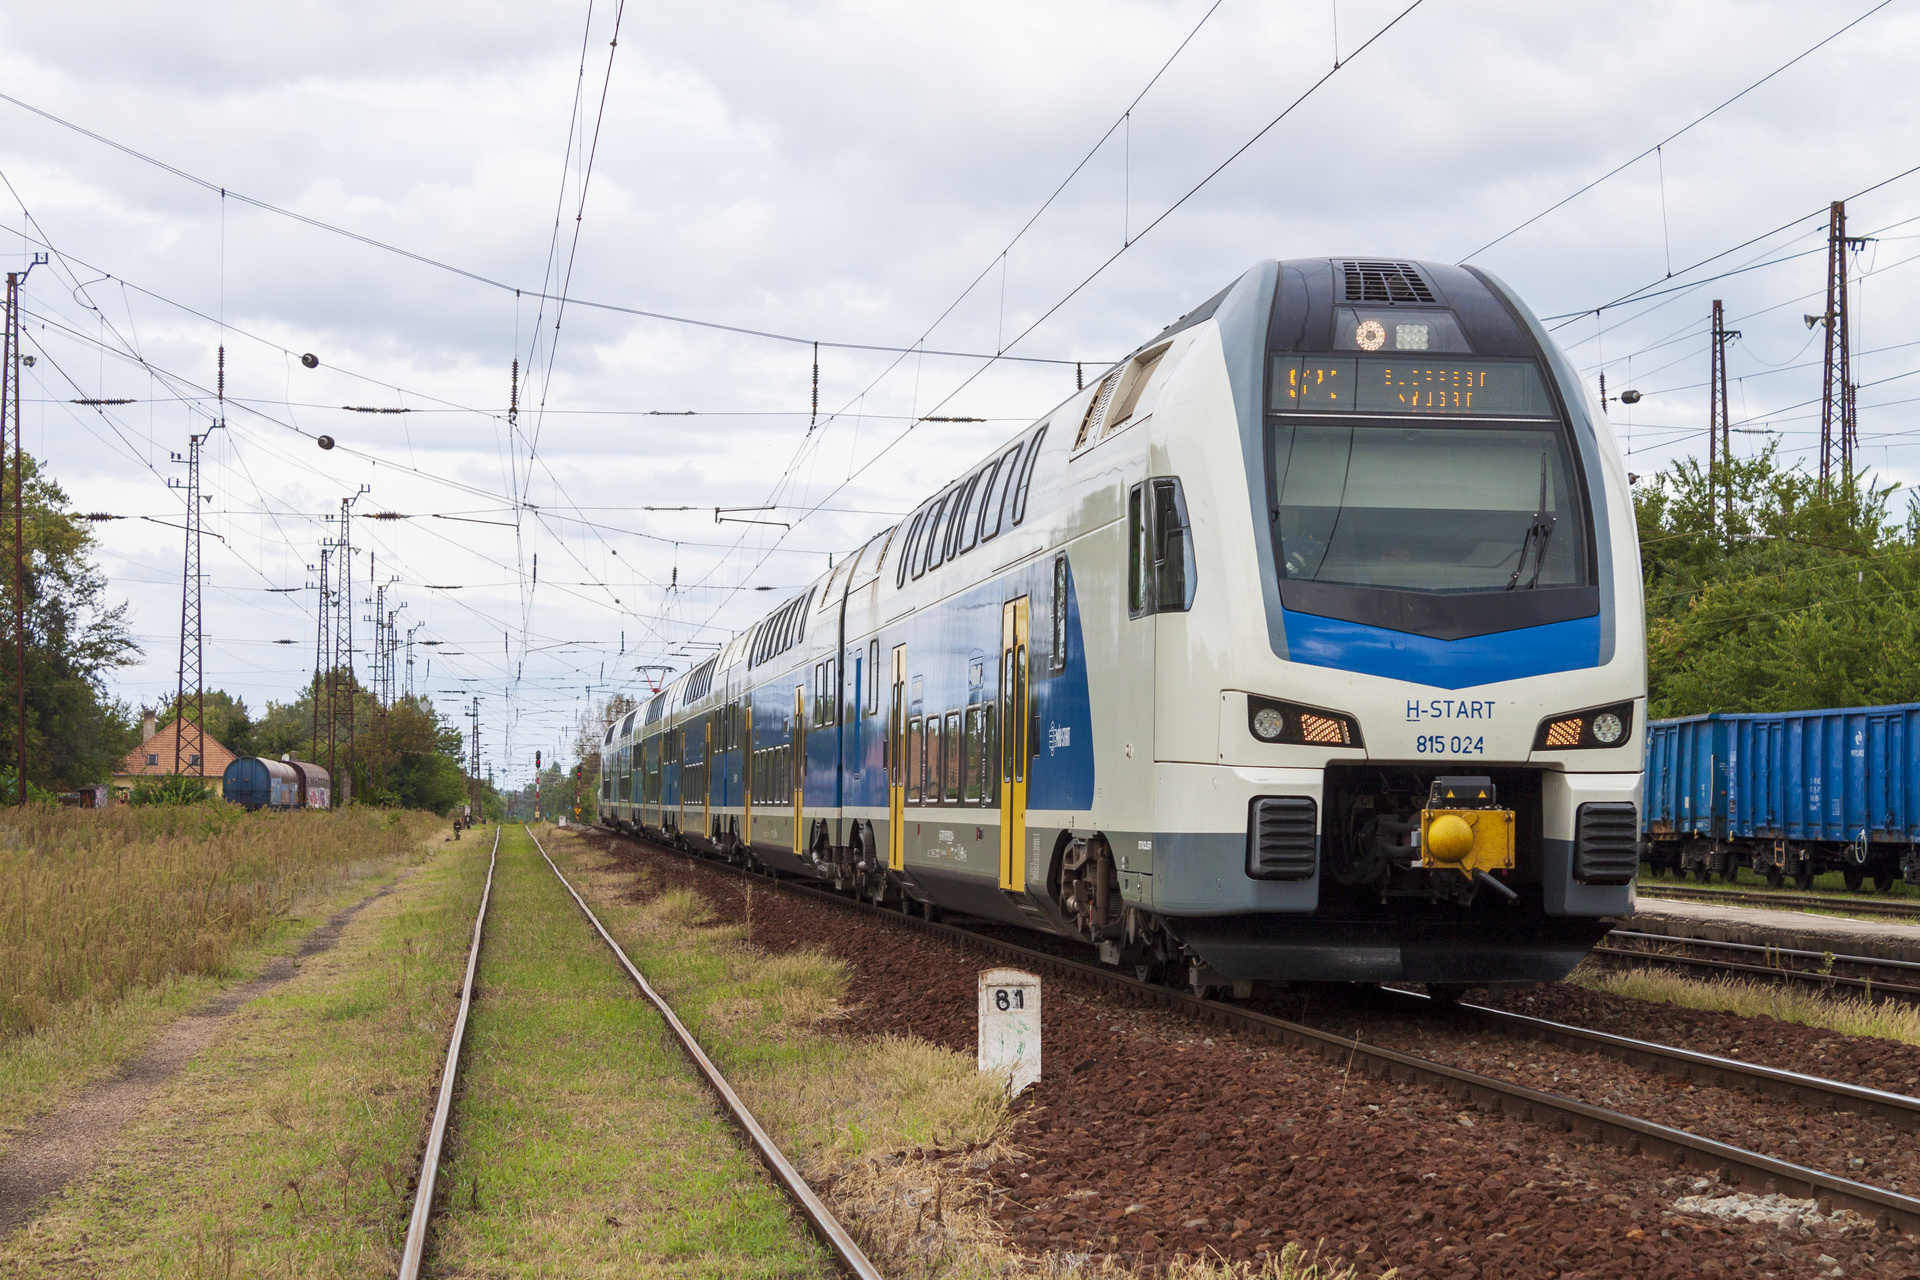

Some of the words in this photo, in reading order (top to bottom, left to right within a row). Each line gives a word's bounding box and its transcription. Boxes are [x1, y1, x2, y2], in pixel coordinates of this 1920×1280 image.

[1406, 700, 1496, 721] H-START
[1416, 735, 1445, 754] 815
[1450, 736, 1484, 755] 024
[995, 988, 1024, 1012] 81
